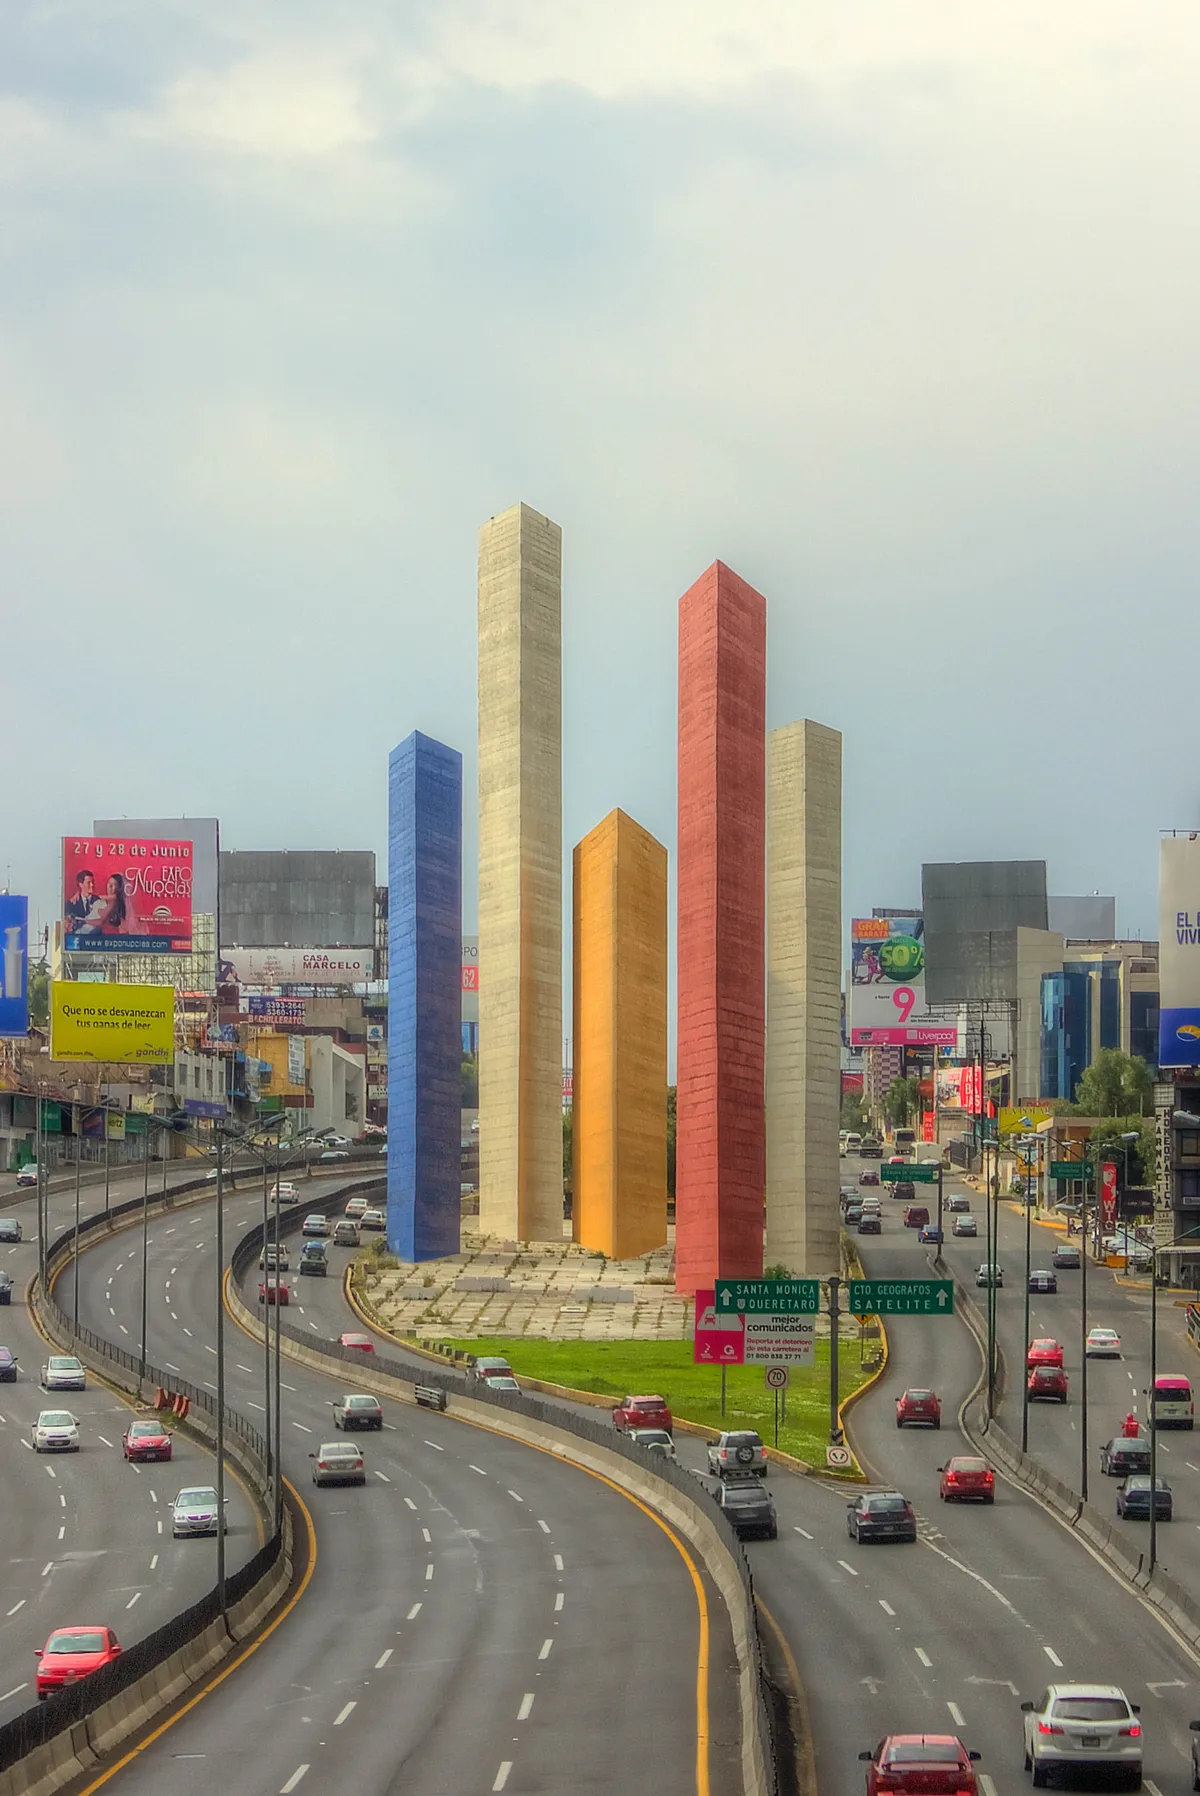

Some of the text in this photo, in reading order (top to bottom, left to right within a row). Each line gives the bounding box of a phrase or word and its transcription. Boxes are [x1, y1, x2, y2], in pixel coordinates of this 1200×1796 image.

[74, 842, 190, 858] 27 y 28 de Junio
[162, 866, 192, 882] EXPO
[1177, 912, 1193, 927] EL
[858, 921, 888, 930] GRAN
[882, 946, 925, 966] 50%
[303, 962, 360, 970] MARCELO
[462, 969, 475, 988] 62
[892, 987, 916, 1023] 9
[62, 1005, 166, 1019] Que no se desvanezcan
[77, 1020, 90, 1028] tus
[121, 1021, 133, 1029] de
[134, 1021, 153, 1030] leer.
[918, 1030, 954, 1041] Liverpool
[136, 1048, 169, 1058] gandhi
[736, 1284, 816, 1295] SANTA MONICA
[854, 1284, 931, 1296] CTO. GEOGRAFOS
[749, 1299, 816, 1310] QUERETARO
[854, 1299, 931, 1310] SATELITE
[771, 1315, 801, 1325] mejor
[747, 1323, 814, 1333] comunicados
[772, 1371, 782, 1380] 70
